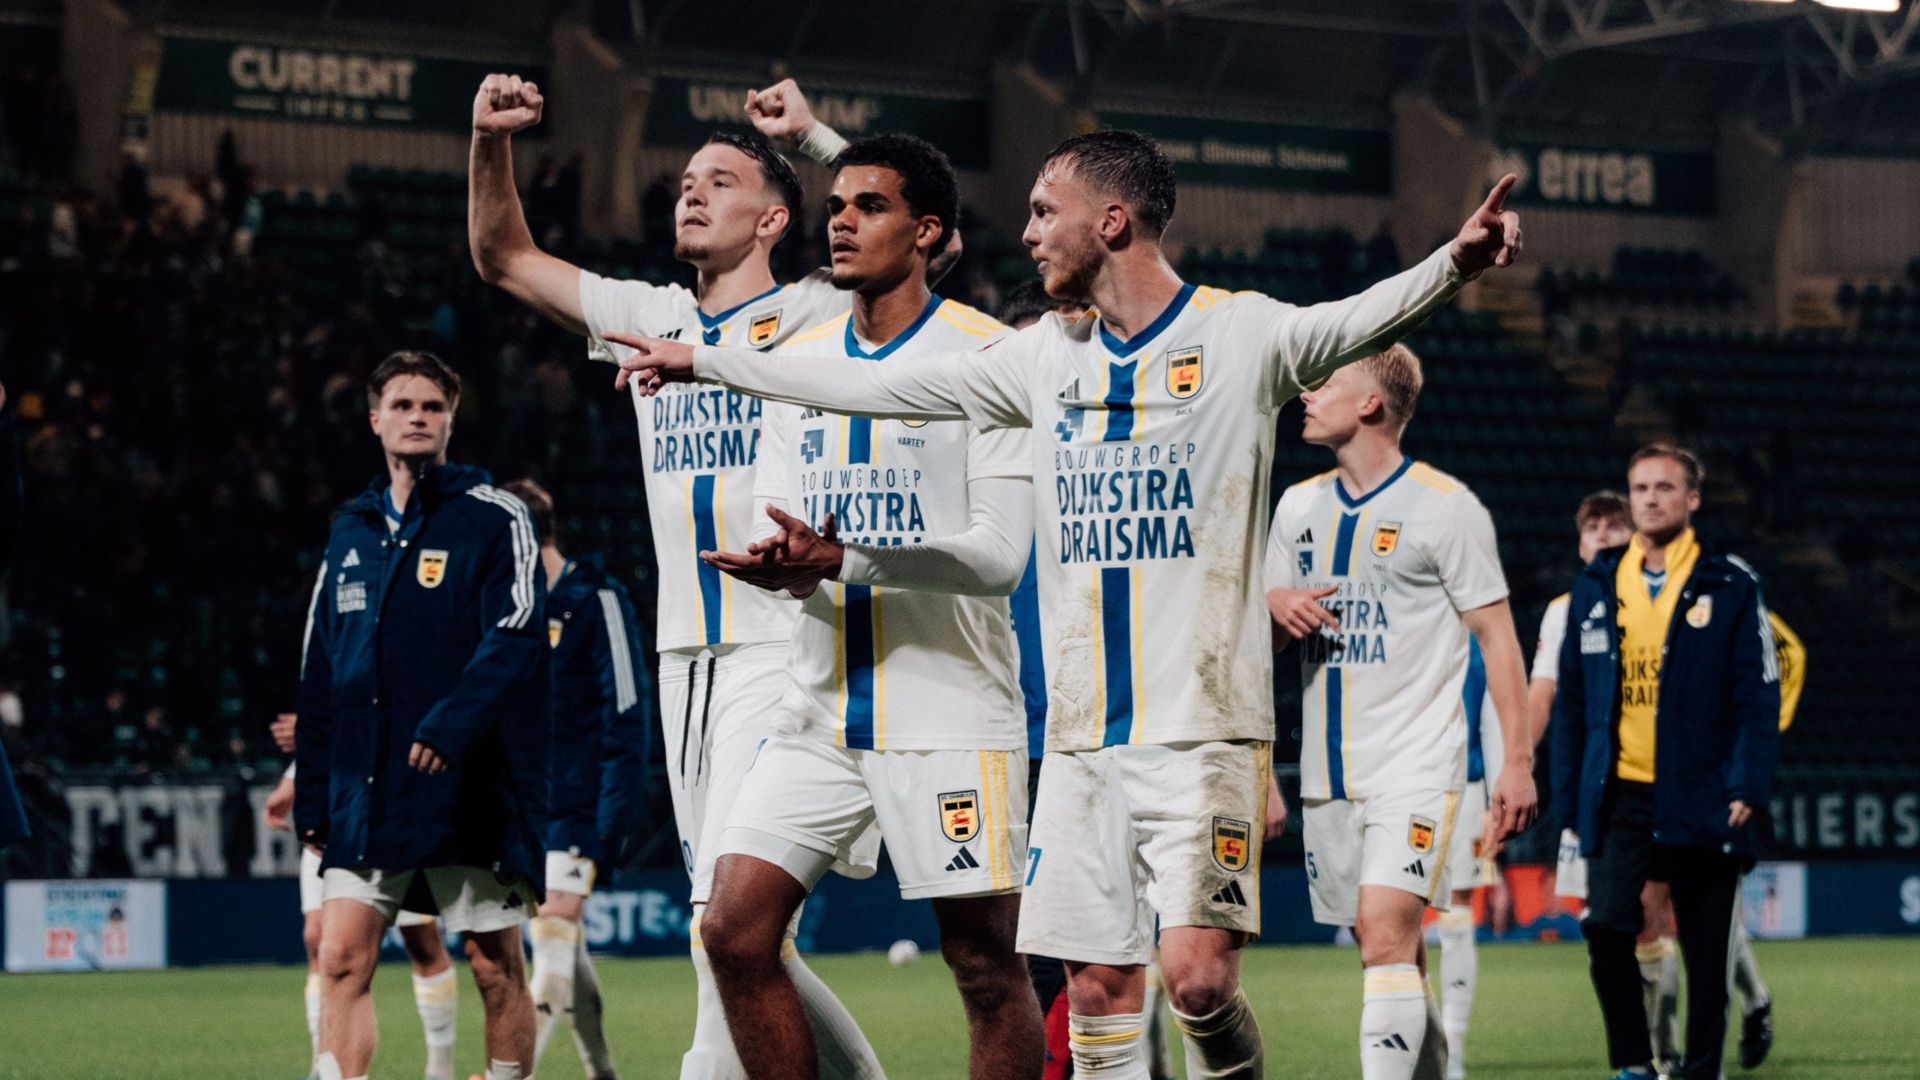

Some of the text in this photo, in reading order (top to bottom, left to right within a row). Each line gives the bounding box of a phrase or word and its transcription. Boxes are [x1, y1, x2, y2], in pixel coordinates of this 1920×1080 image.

[229, 48, 415, 102] CURRENT
[653, 389, 762, 432] DIJKSTRA
[1055, 442, 1196, 472] BOUWGROEP
[802, 467, 921, 494] BOUWGROEP
[1056, 467, 1194, 517] DIJKSTRA
[1060, 515, 1196, 564] DRAISMA
[1025, 846, 1043, 887] 7
